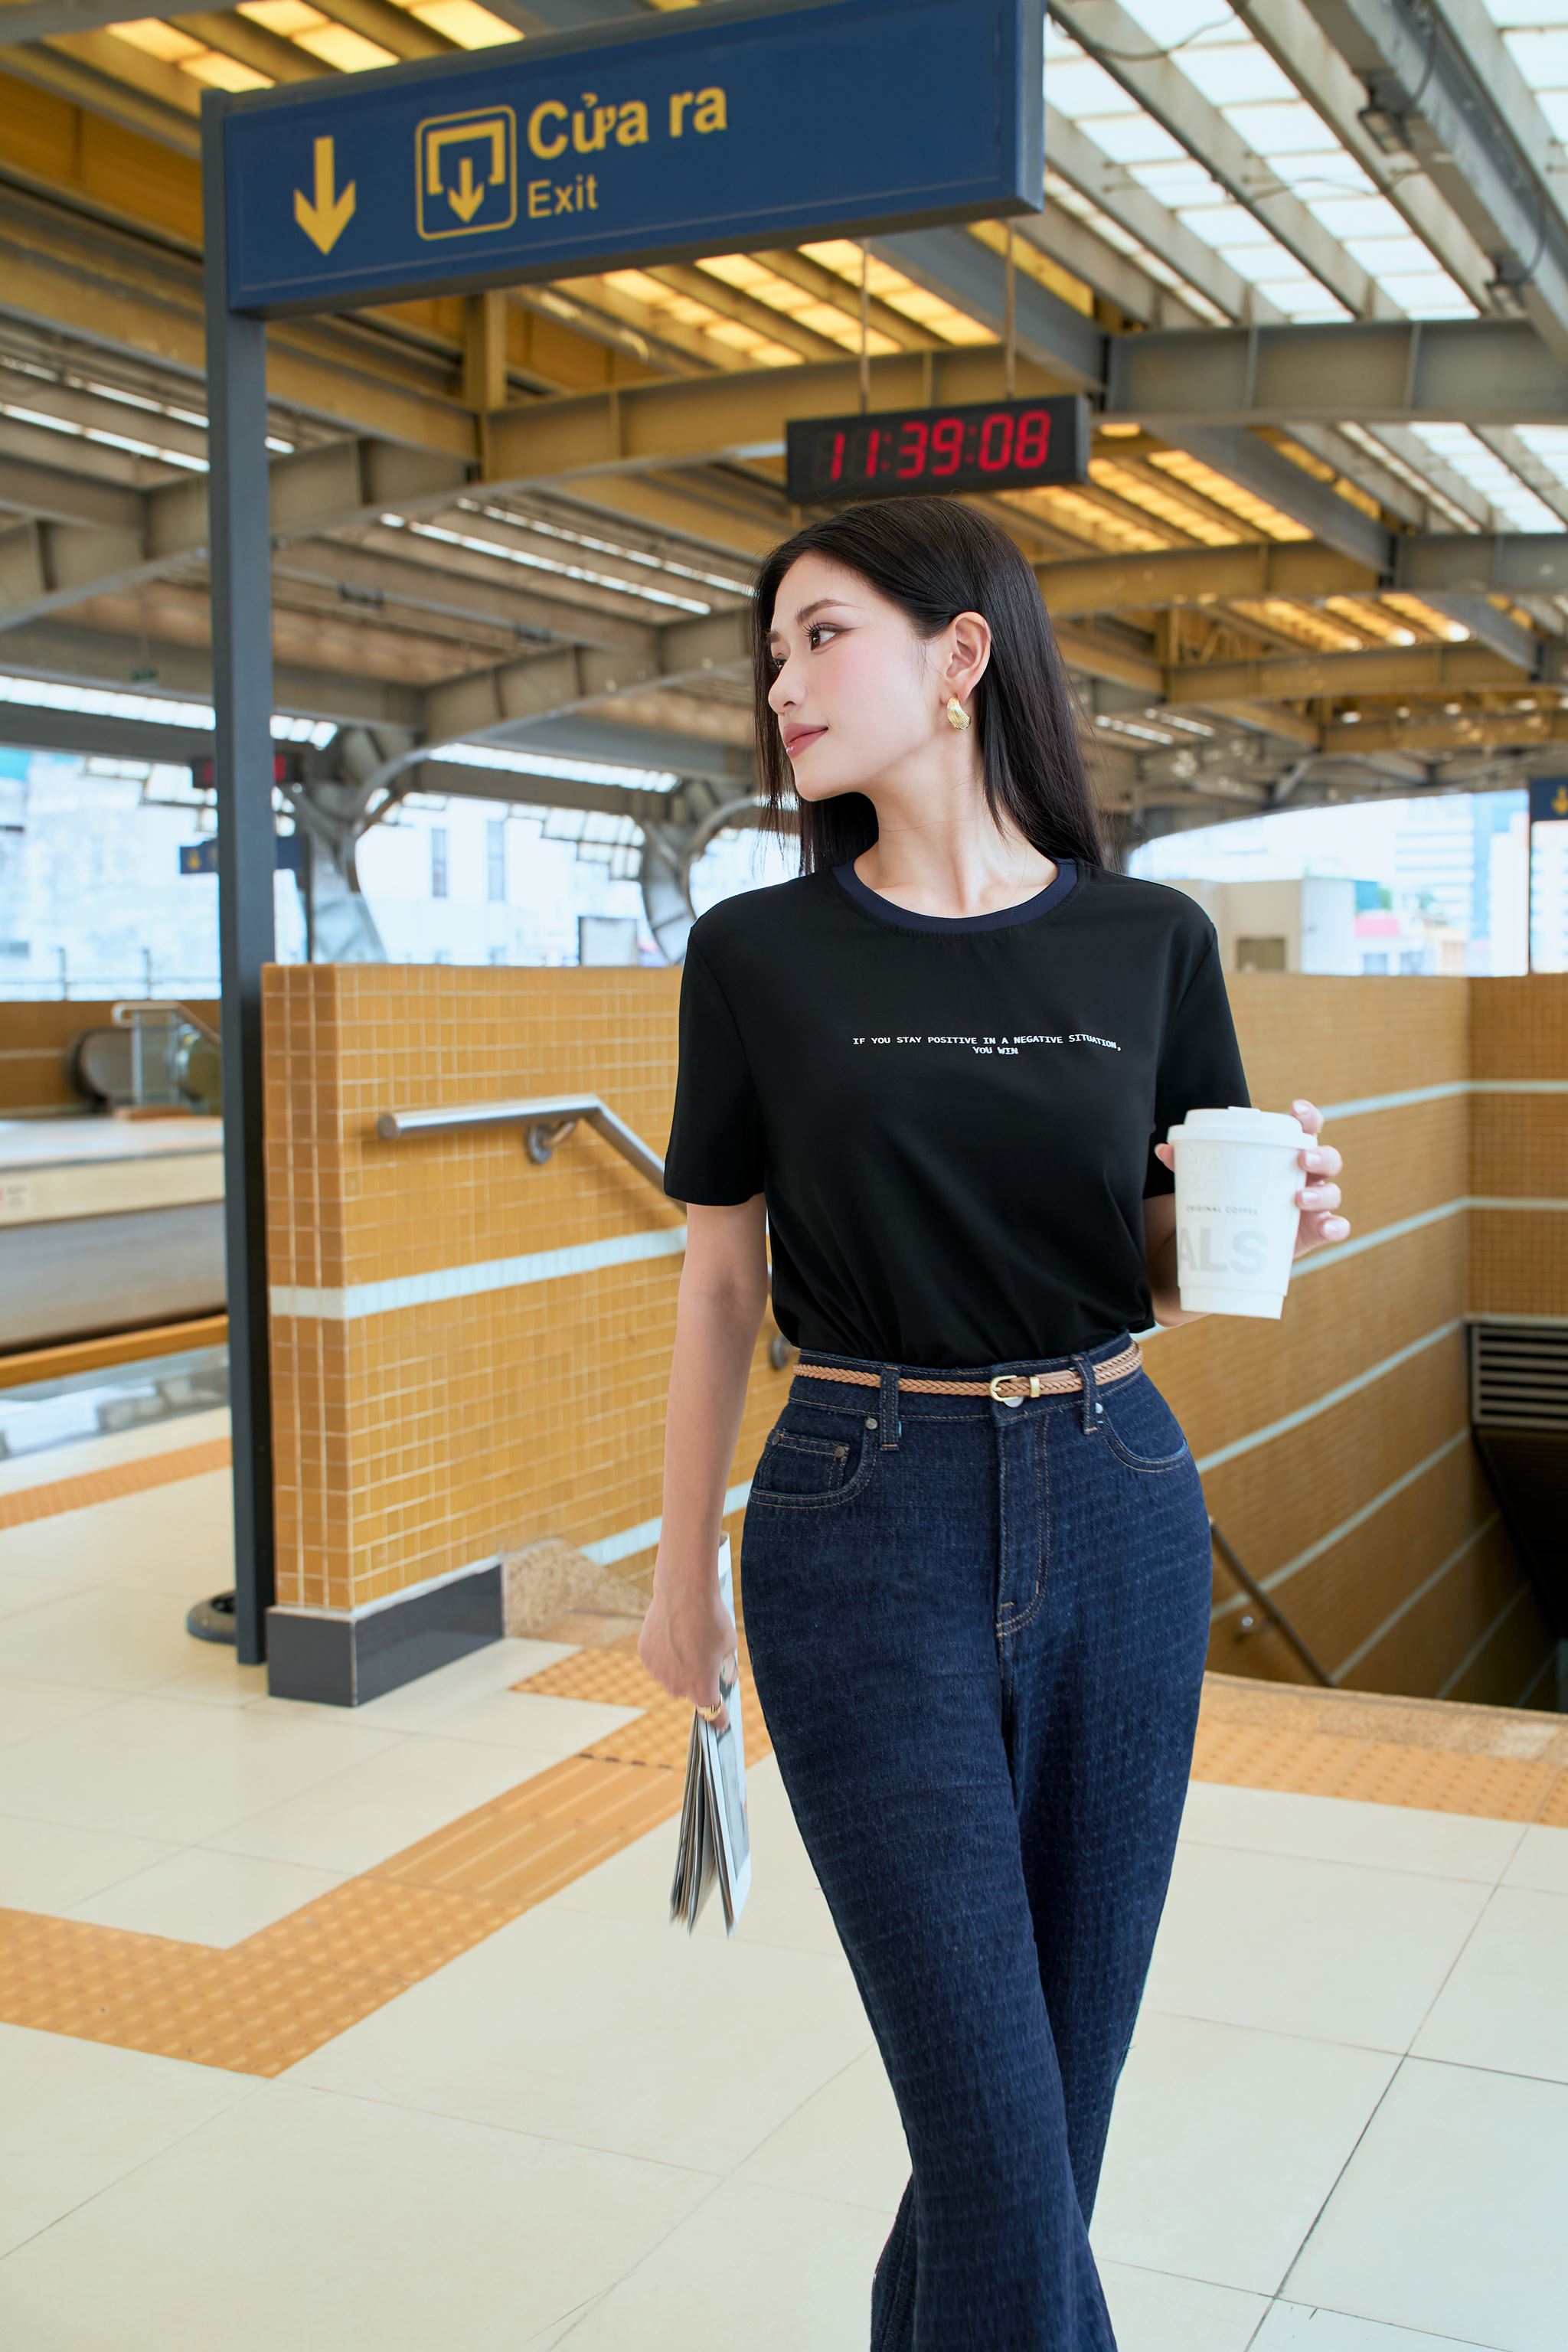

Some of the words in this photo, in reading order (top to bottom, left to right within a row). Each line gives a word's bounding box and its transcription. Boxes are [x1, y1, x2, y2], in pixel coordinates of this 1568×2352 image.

[528, 93, 649, 160] Cửa
[669, 86, 727, 139] ra
[528, 174, 598, 219] Exit
[831, 409, 1052, 481] 11:39:08
[927, 1036, 978, 1044] POSITIVE
[1013, 1035, 1063, 1044] NEGATIVE
[1068, 1034, 1122, 1051] SITUATION,
[972, 1046, 993, 1054] YOU
[996, 1046, 1019, 1055] WIN
